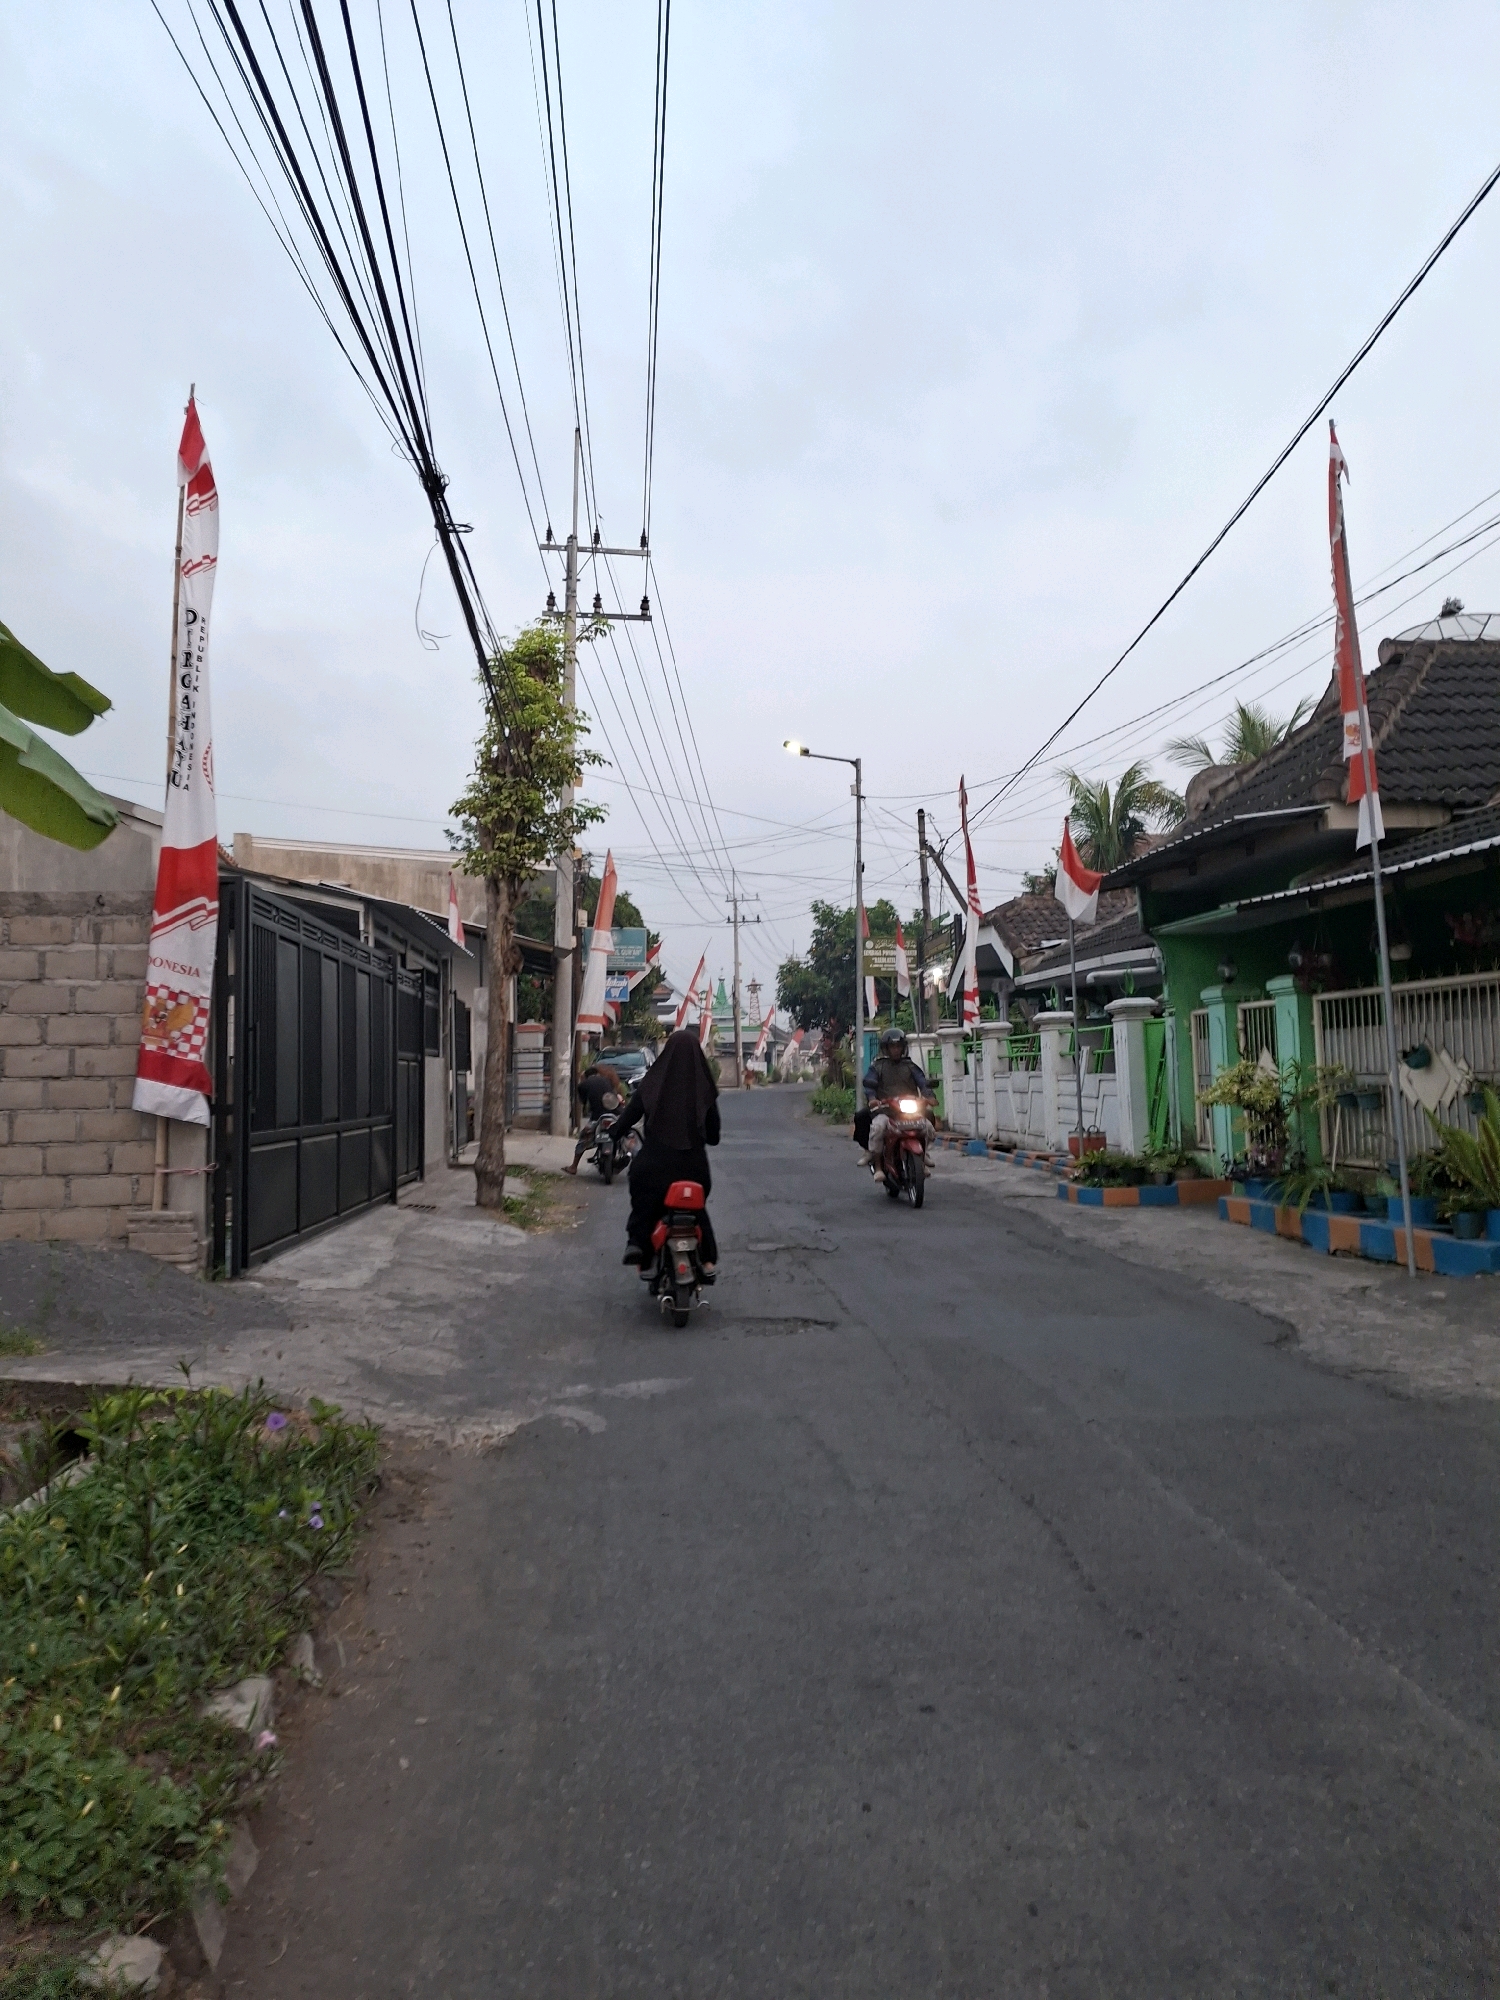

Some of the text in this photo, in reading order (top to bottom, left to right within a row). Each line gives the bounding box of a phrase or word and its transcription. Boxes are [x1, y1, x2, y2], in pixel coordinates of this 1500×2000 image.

[170, 608, 198, 788] DIRGAHAYU
[183, 617, 206, 791] REPUBLIK INDONESIA
